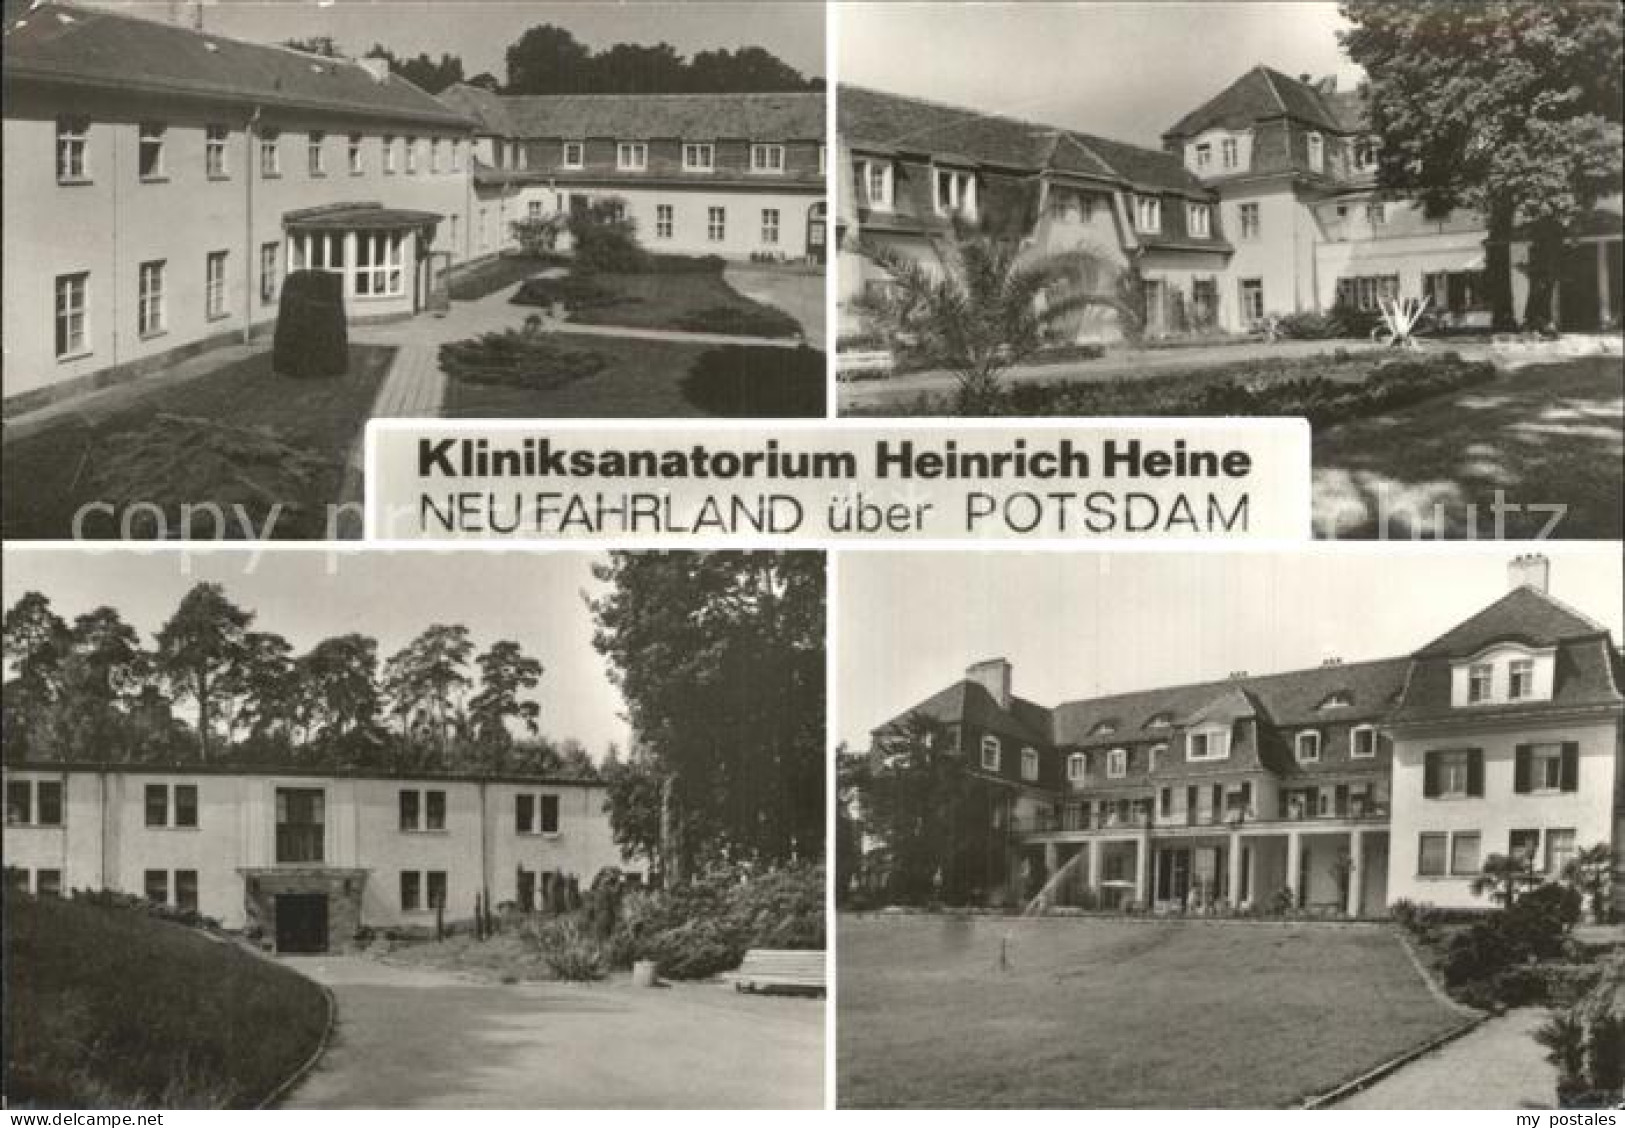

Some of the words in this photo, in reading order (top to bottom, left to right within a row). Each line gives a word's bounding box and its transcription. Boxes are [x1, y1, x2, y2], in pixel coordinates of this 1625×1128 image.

[419, 438, 856, 479] Kliniksanatorium
[876, 440, 1089, 479] Heinrich
[1104, 440, 1252, 478] Heine
[420, 492, 521, 534] NEU
[535, 492, 804, 534] FAHRLAND
[828, 491, 934, 533] über
[967, 491, 1250, 533] POTSDAM
